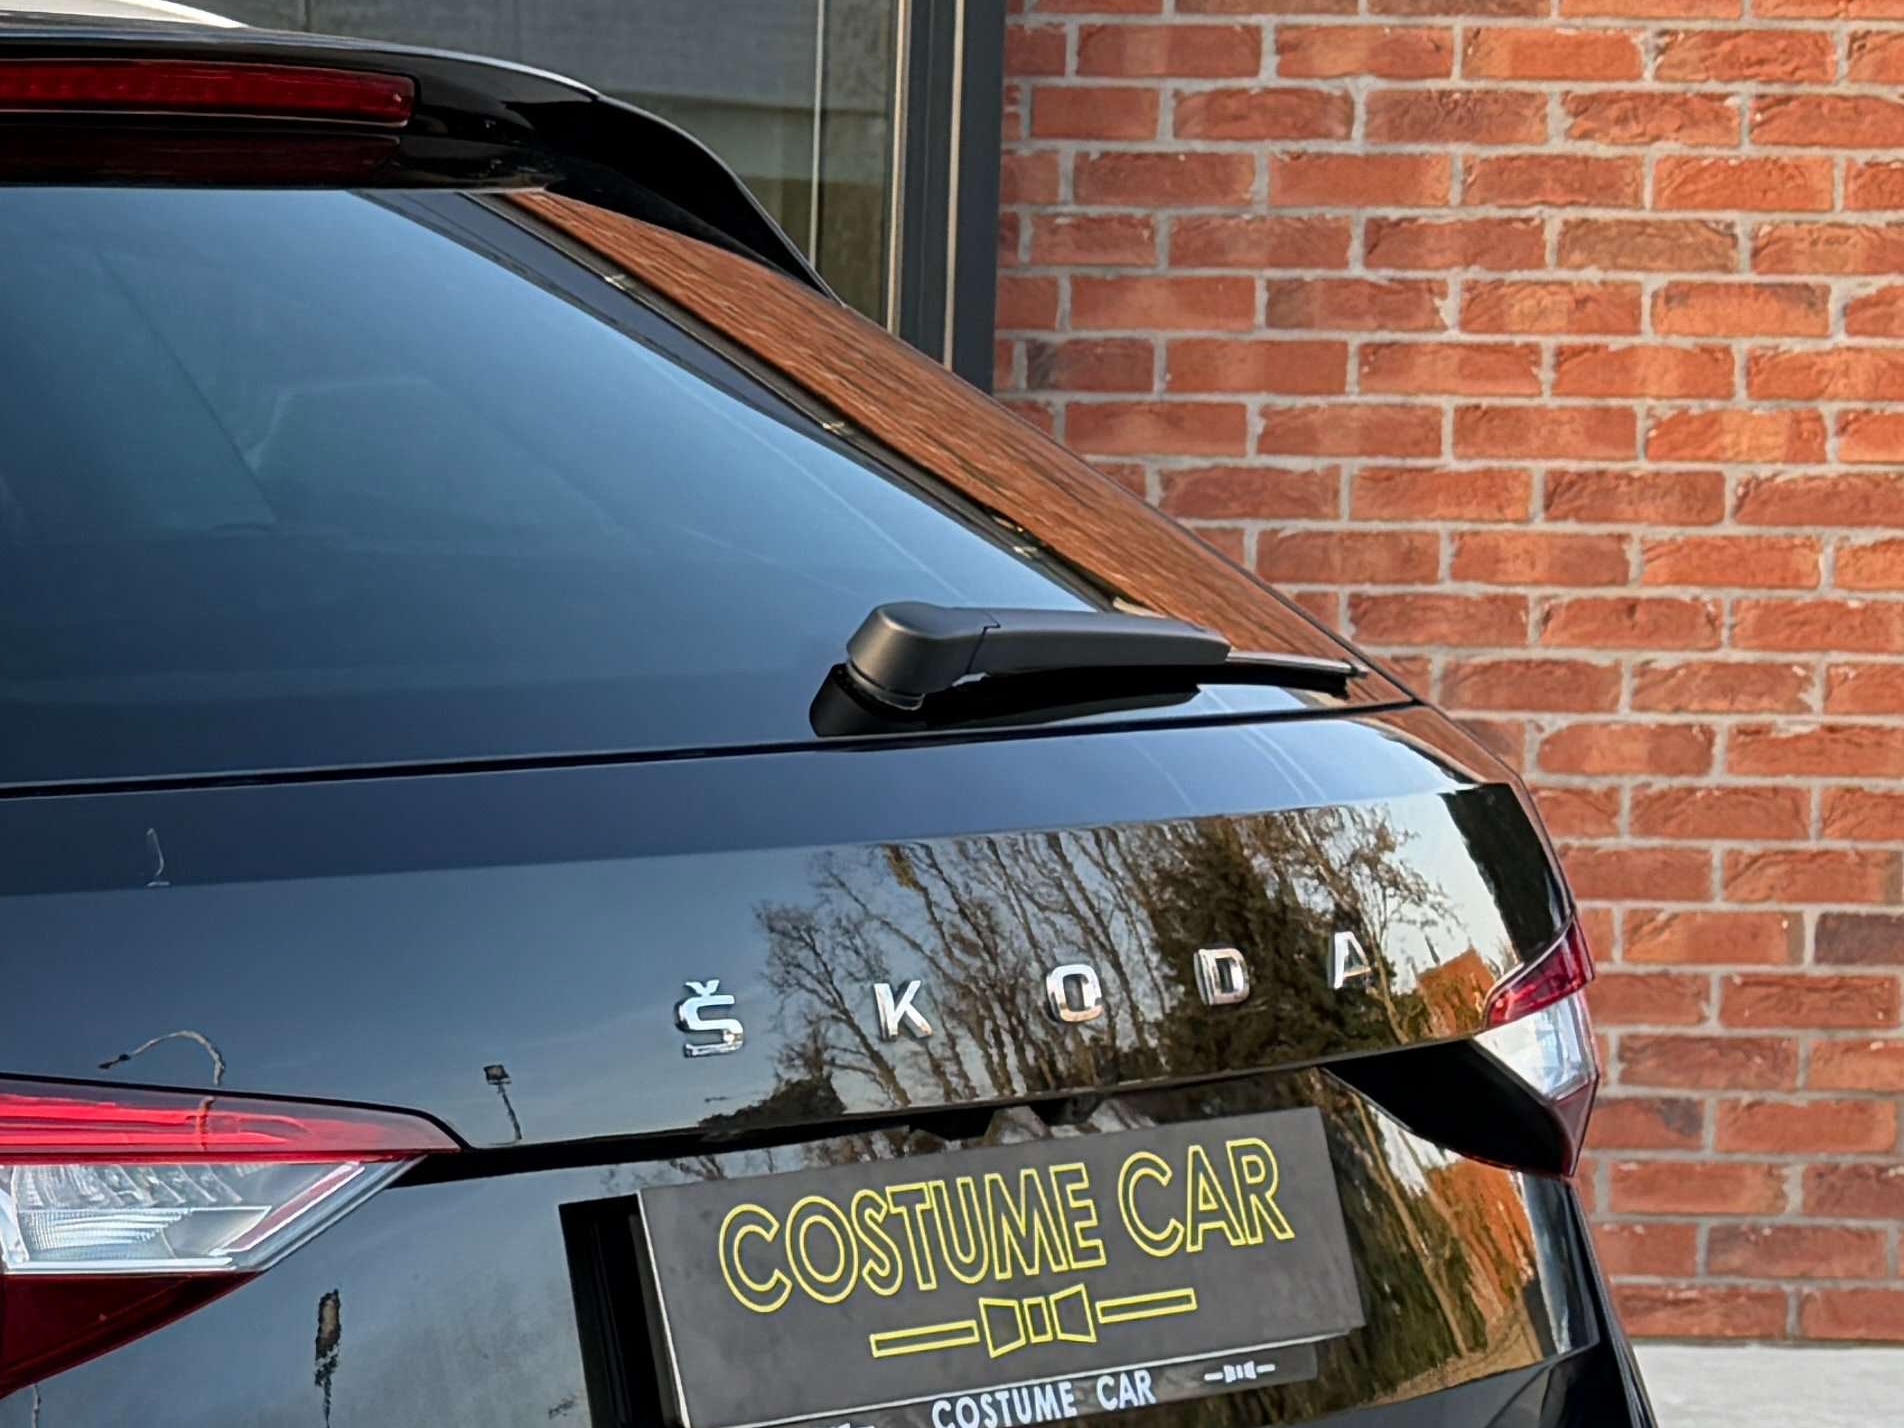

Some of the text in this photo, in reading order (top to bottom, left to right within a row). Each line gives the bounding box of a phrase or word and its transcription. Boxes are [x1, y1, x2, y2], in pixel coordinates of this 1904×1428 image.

[676, 930, 1371, 1057] ŠKODA
[718, 1137, 1294, 1312] COSTUME CAR
[1097, 1369, 1156, 1413] CAR
